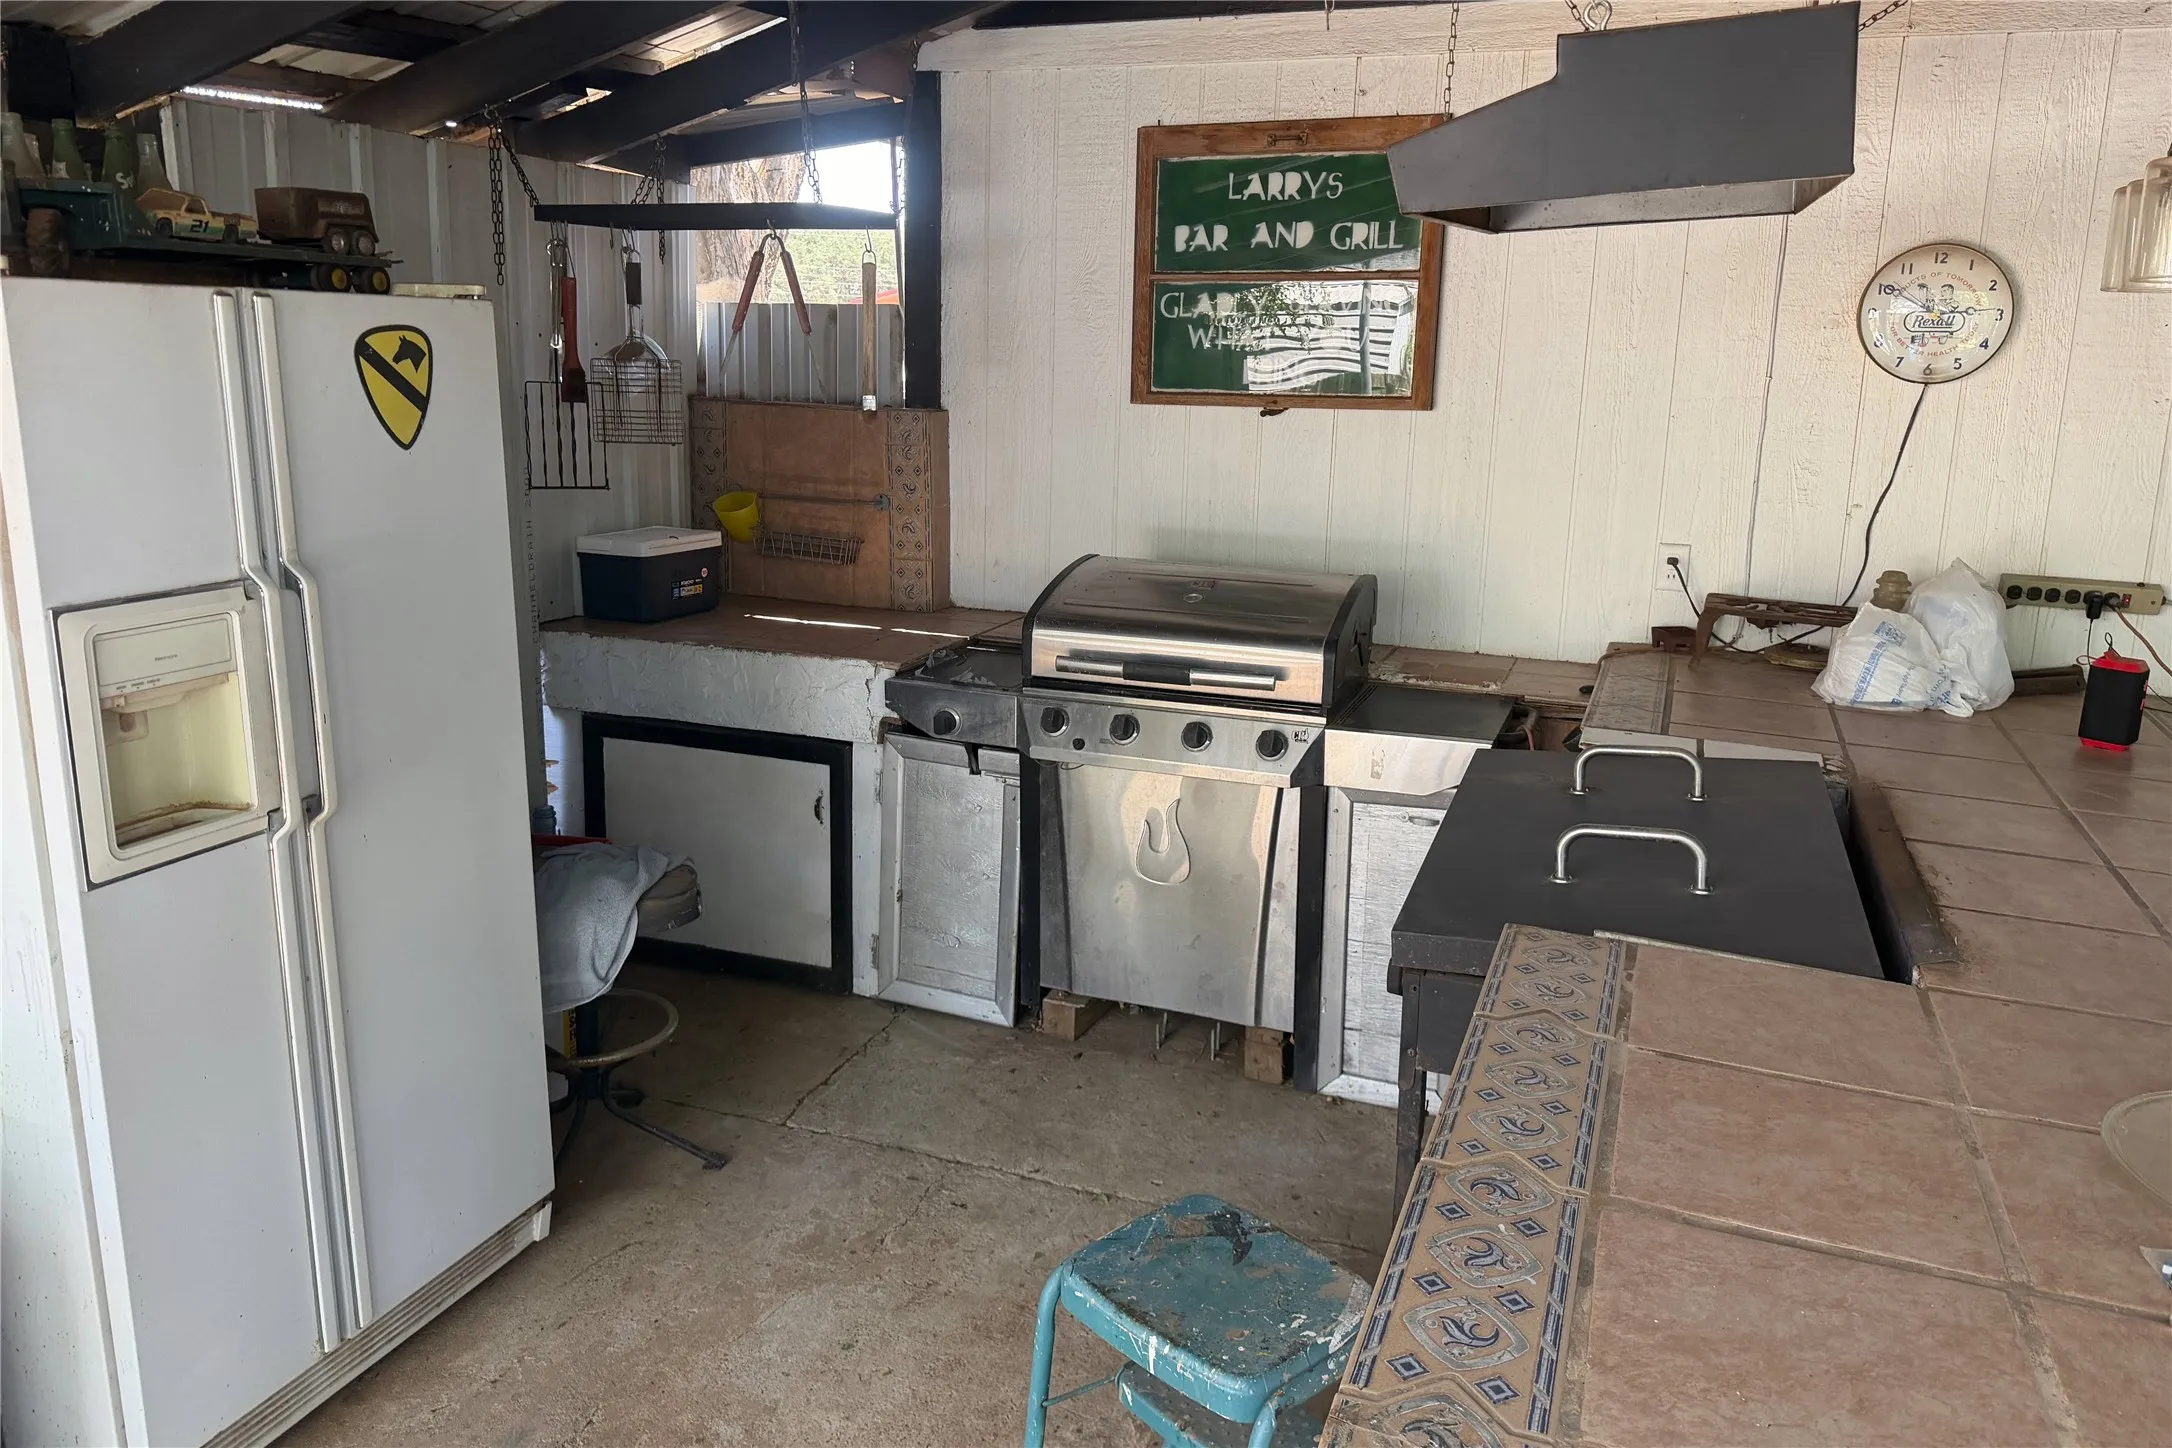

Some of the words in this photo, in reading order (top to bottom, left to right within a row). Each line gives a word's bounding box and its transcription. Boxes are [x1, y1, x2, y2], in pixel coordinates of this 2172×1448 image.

[1228, 172, 1343, 201] LARRYS
[190, 219, 209, 233] 21
[1174, 223, 1229, 252] BAR
[1251, 221, 1314, 249] AND
[1330, 220, 1403, 250] GRILL
[1934, 252, 1949, 264] 12
[1901, 262, 1914, 275] 11
[1968, 259, 1975, 271] 1
[1878, 283, 1896, 296] 10
[1946, 272, 1982, 307] TOMORROW
[1988, 279, 1998, 291] 2
[1911, 314, 1956, 329] Rexall
[1994, 308, 2004, 322] 3
[1927, 343, 1959, 357] HEALTH
[1979, 337, 1989, 350] 4
[1895, 356, 1905, 368] 7
[1953, 357, 1962, 370] 5
[1923, 363, 1933, 376] 6
